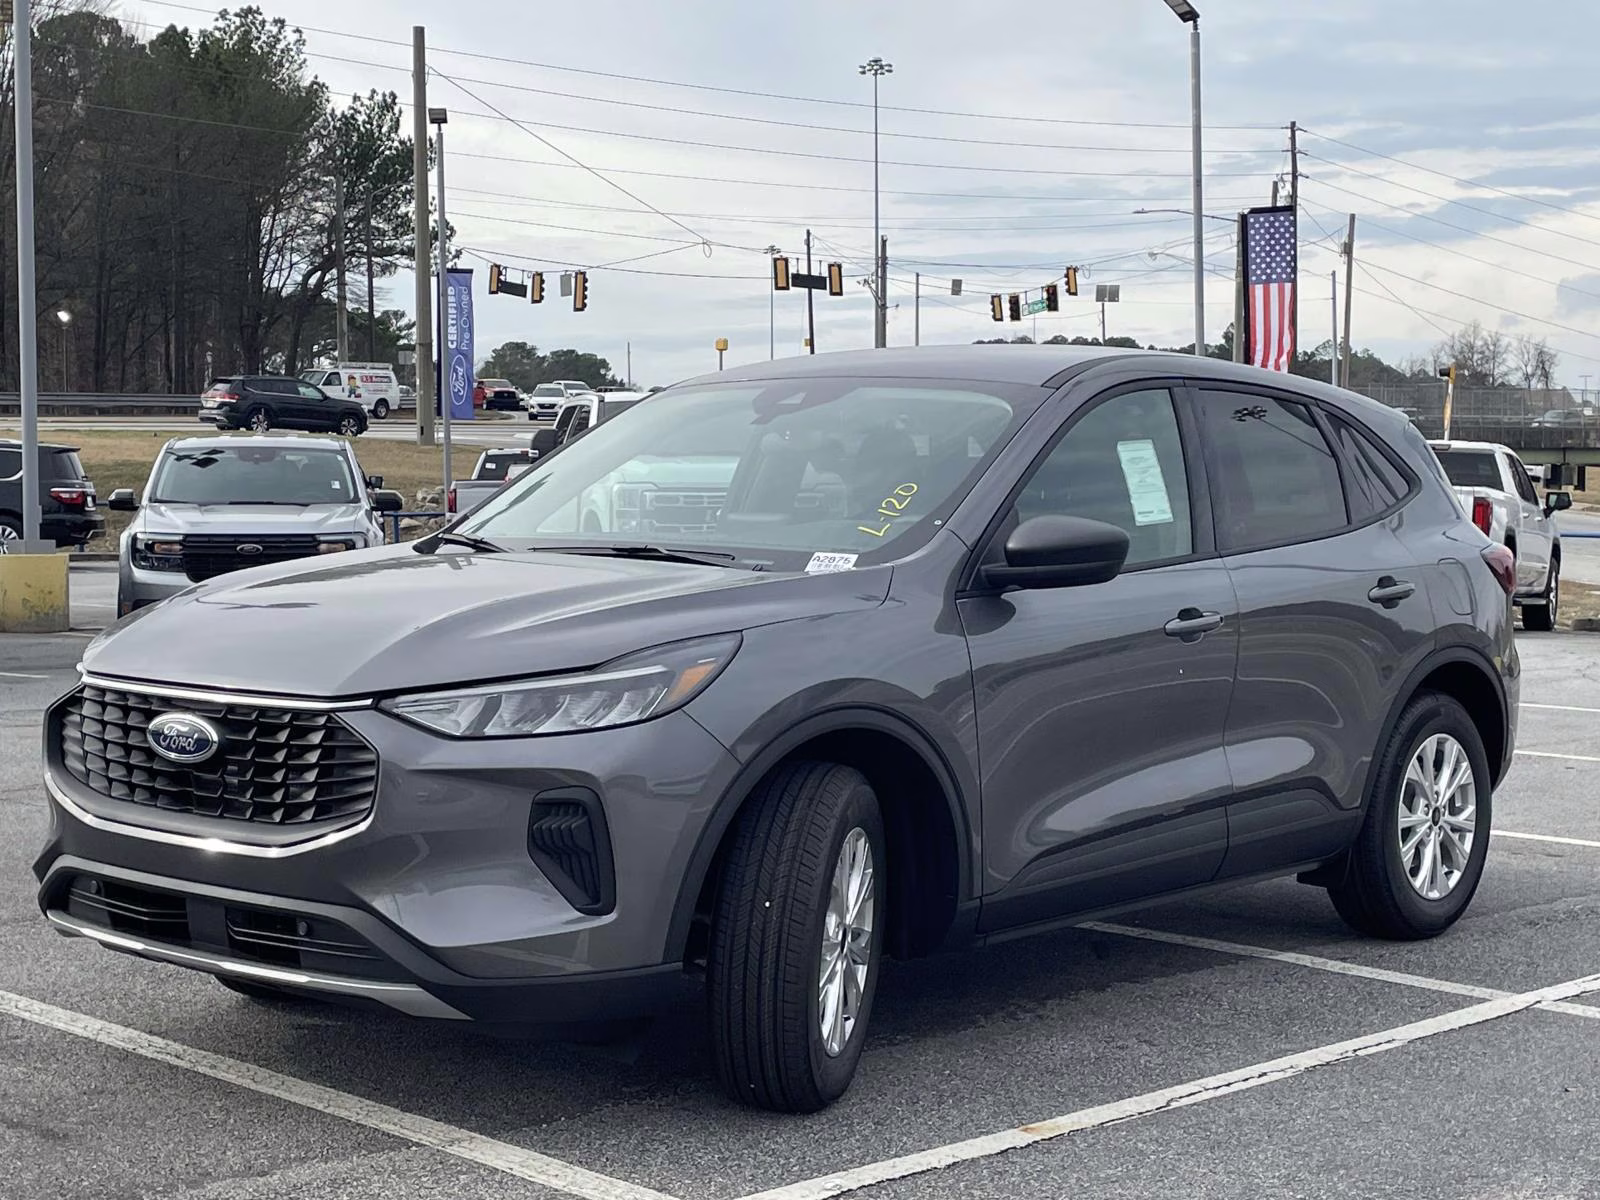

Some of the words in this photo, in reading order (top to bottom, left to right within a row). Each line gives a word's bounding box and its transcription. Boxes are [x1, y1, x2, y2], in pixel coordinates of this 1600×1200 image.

[448, 286, 457, 349] CERTIFIED
[459, 286, 470, 350] Pre-Owned
[452, 365, 464, 396] Ford
[160, 723, 199, 751] Ford
